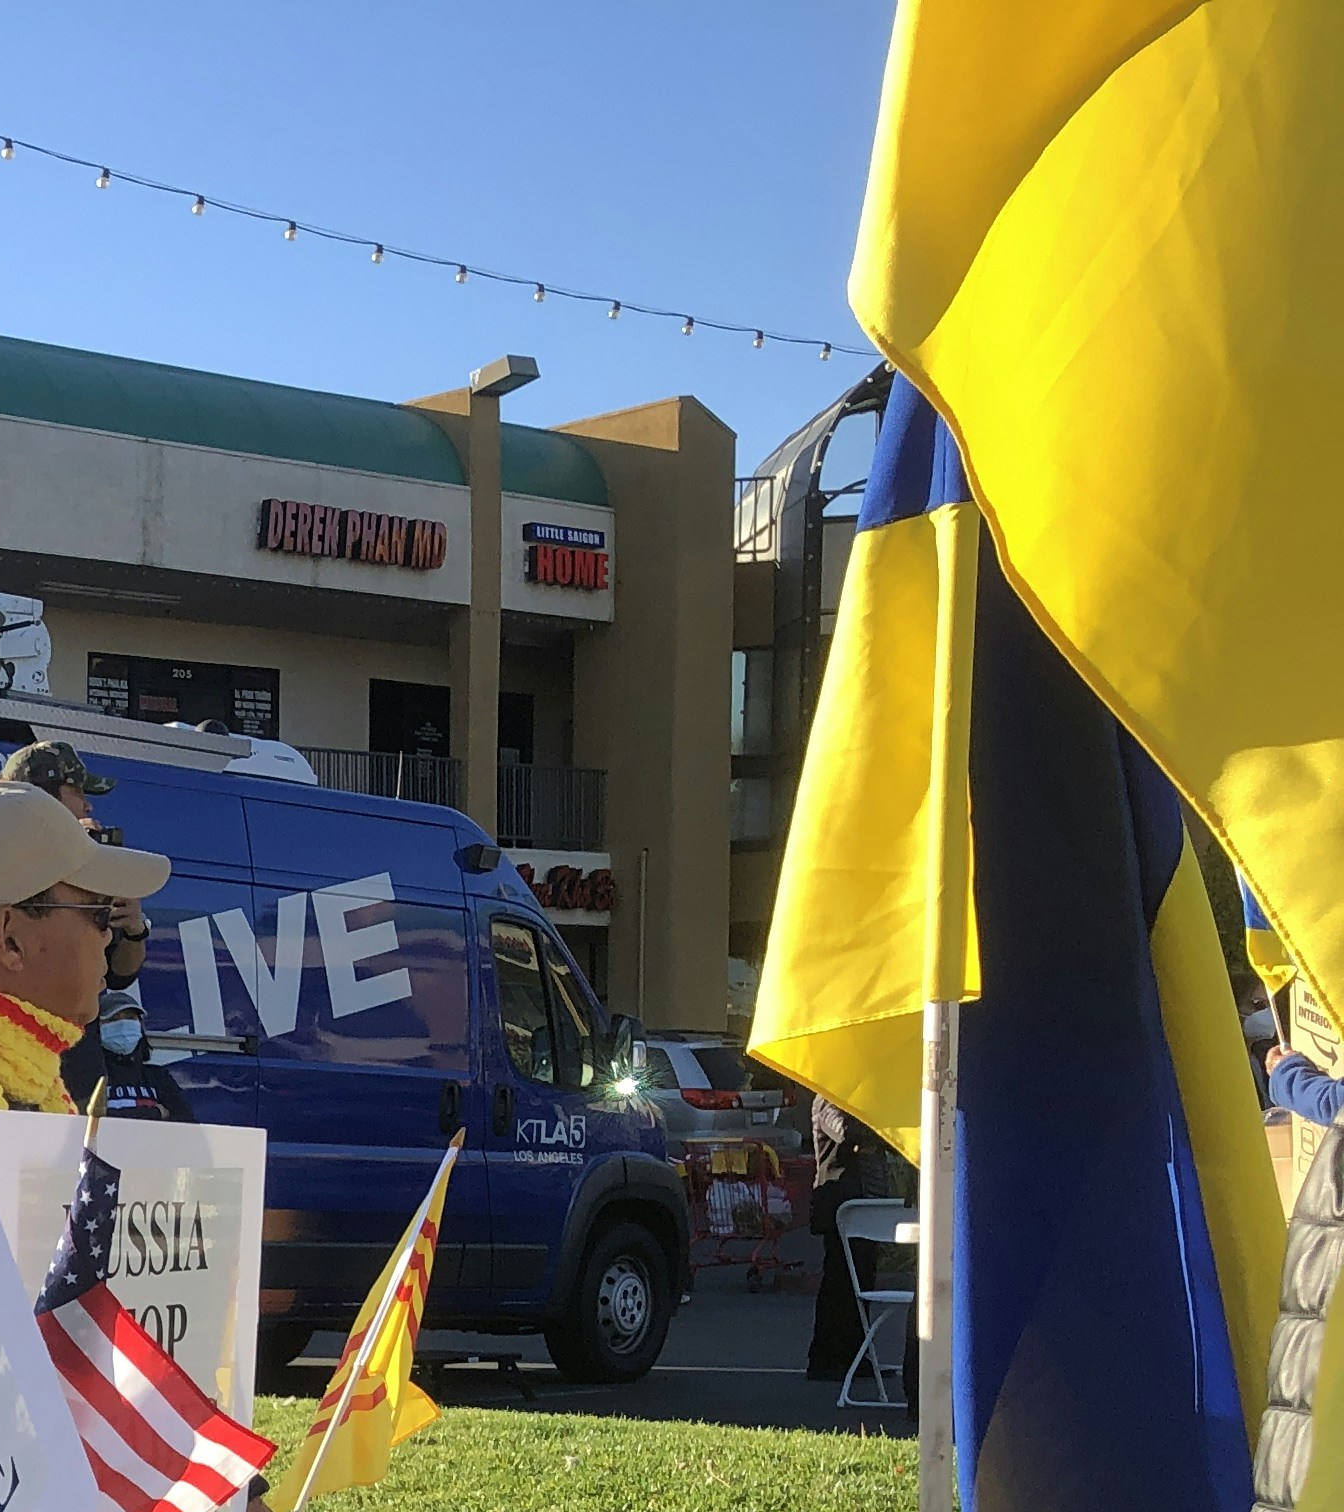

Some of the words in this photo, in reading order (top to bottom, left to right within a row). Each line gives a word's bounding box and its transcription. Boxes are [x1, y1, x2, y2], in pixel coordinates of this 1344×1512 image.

[266, 499, 342, 557] DEREK
[345, 510, 408, 566] PHAN
[412, 519, 448, 570] MD
[536, 525, 565, 541] LITTLE
[567, 530, 601, 546] SAIGON
[534, 545, 609, 590] HOME
[172, 668, 193, 679] 205
[513, 1150, 534, 1162] LOS
[538, 1151, 584, 1165] ANGELES
[63, 1200, 209, 1279] USSIA
